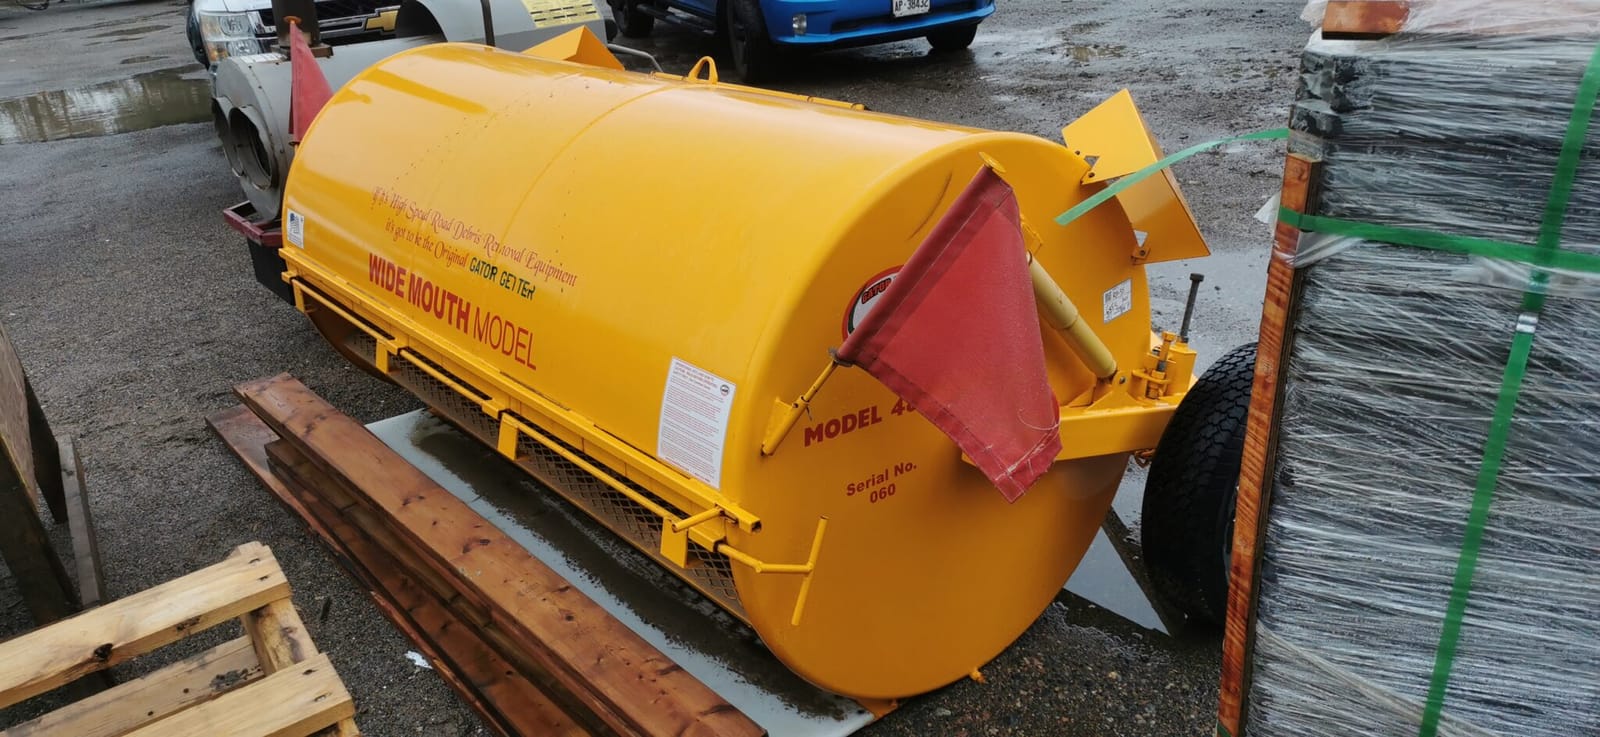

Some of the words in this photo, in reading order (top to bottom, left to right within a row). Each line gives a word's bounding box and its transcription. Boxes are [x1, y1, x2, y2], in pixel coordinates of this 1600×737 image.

[431, 211, 455, 233] Road
[453, 221, 481, 244] Debris
[525, 251, 578, 287] Equipment
[433, 241, 470, 268] Original
[469, 257, 498, 282] GATOR
[499, 271, 536, 301] GETTER
[369, 252, 406, 299] WIDE
[408, 272, 471, 335] MOUTH
[473, 306, 537, 371] MODEL
[804, 405, 883, 447] MODEL
[846, 468, 889, 496] Serial
[894, 462, 917, 477] No.
[869, 483, 896, 503] 060
